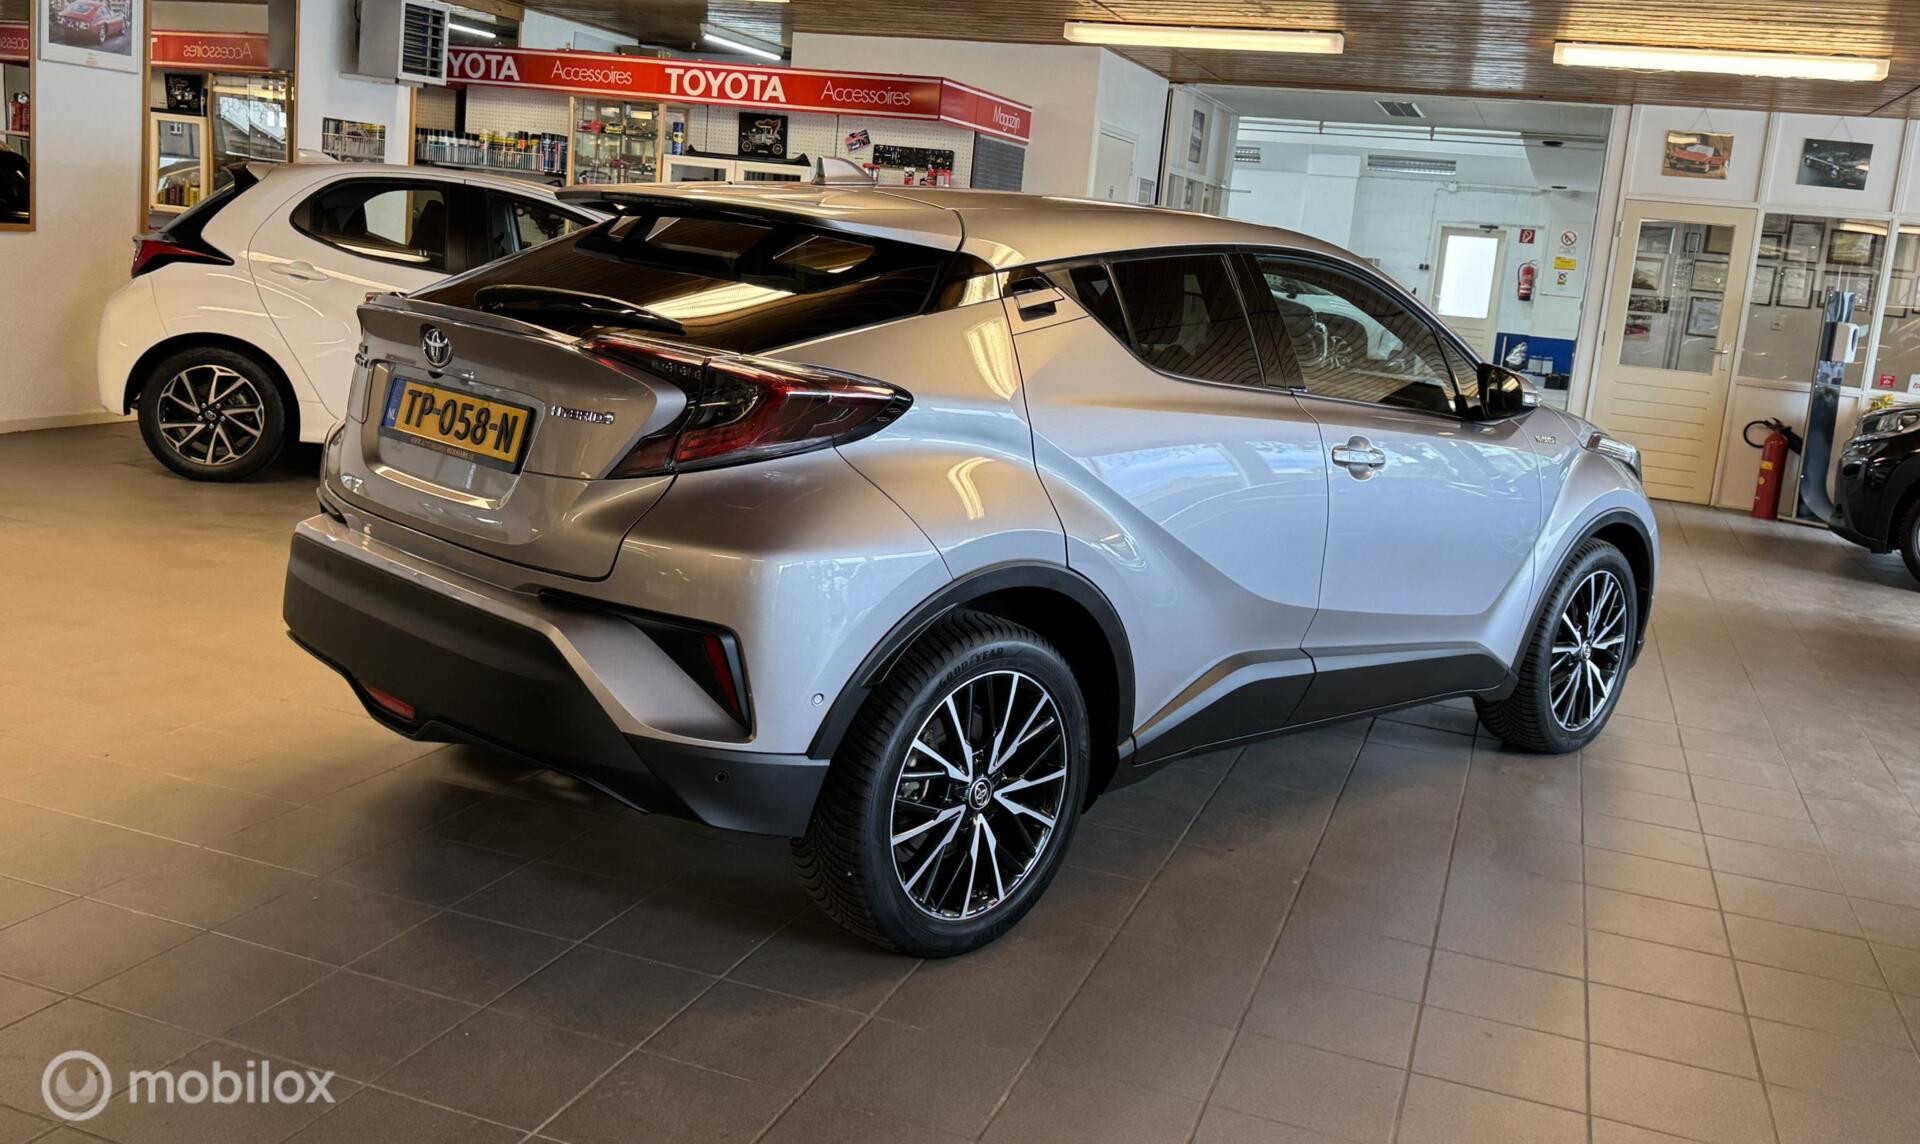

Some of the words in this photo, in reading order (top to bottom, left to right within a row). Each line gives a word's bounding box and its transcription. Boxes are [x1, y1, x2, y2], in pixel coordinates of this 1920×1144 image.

[551, 60, 632, 84] Accessoires
[665, 68, 786, 102] TOYOTA
[821, 80, 911, 106] Accessoires
[404, 389, 518, 454] TP-058-N
